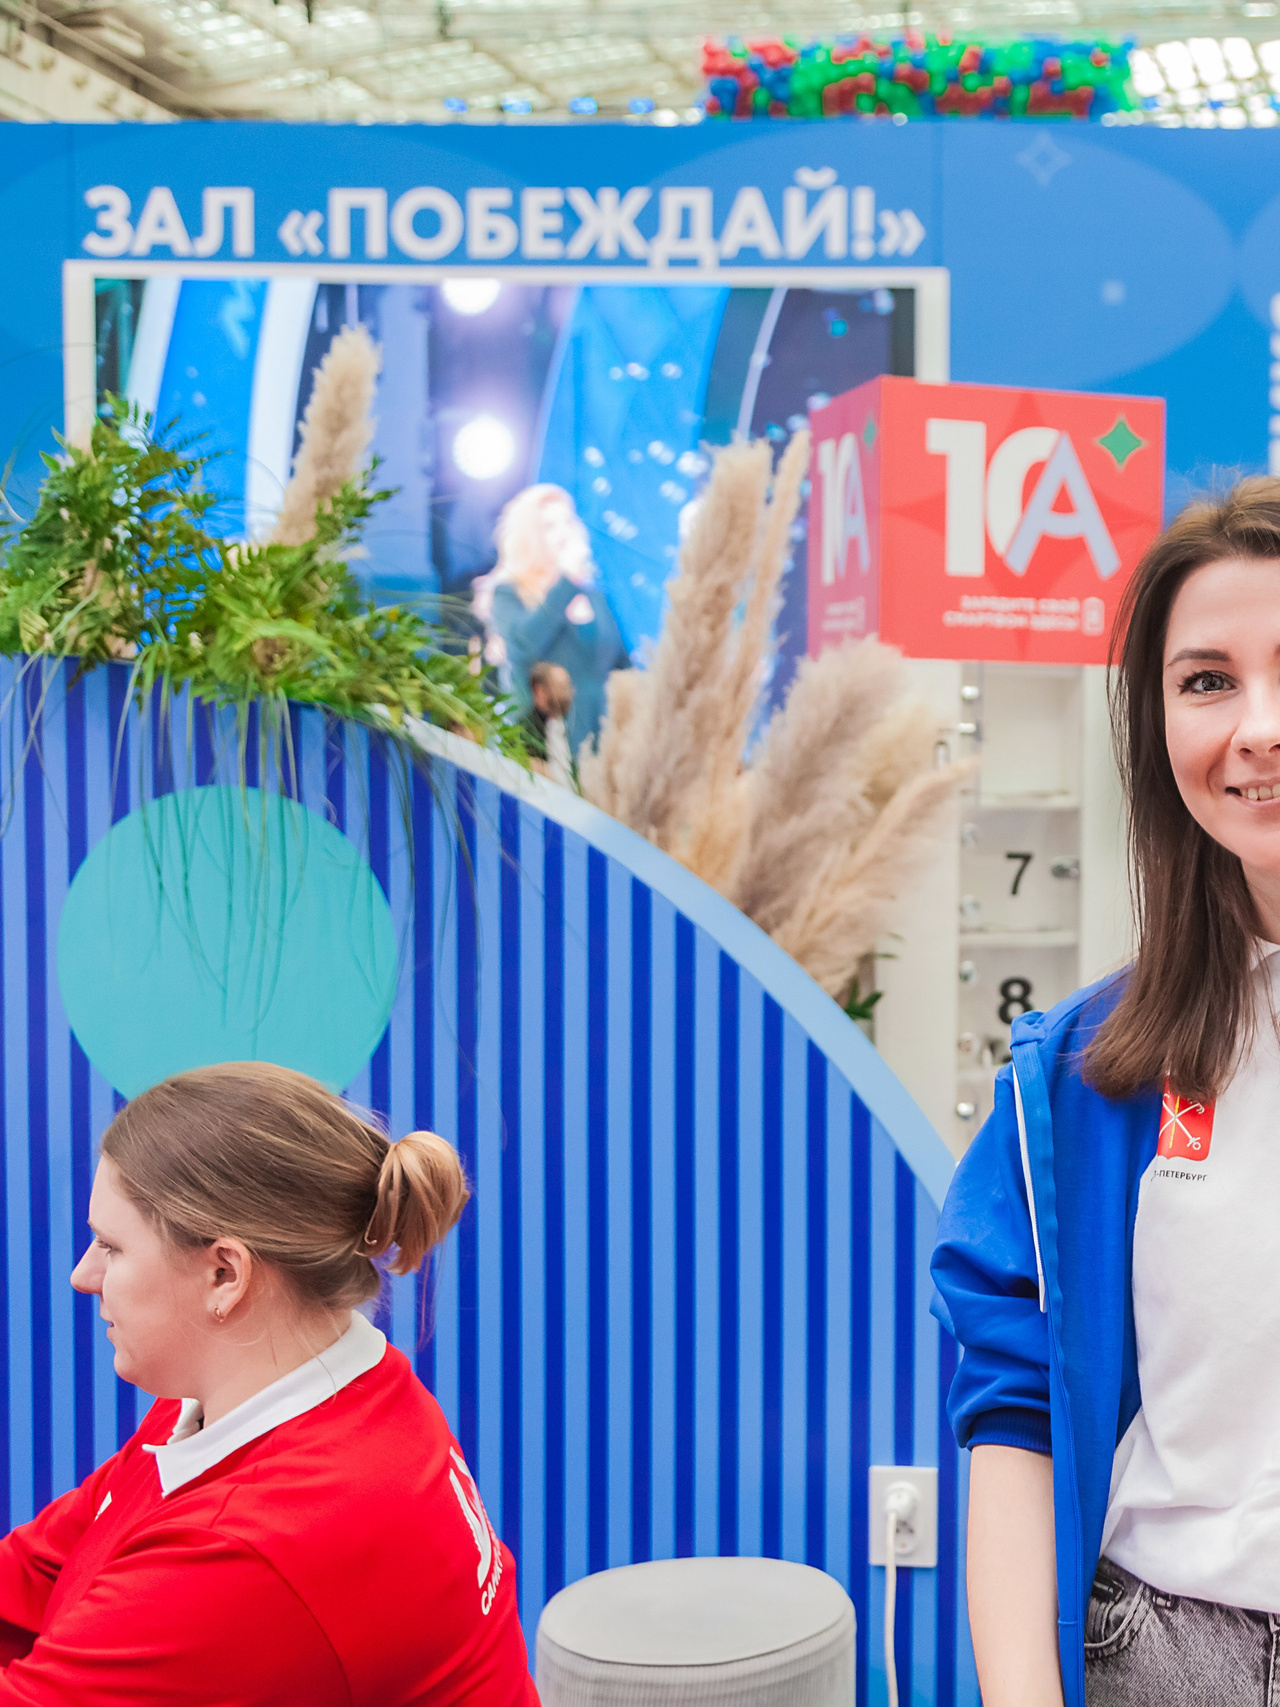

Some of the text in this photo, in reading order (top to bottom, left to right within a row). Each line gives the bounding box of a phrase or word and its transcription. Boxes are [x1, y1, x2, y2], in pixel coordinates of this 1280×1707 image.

[83, 166, 925, 268] ЗАЛ «ПОБЕЖДАЙ!»
[1005, 851, 1034, 896] 7
[999, 976, 1033, 1025] 8
[1154, 1169, 1208, 1182] -ПЕТЕРБУРГ
